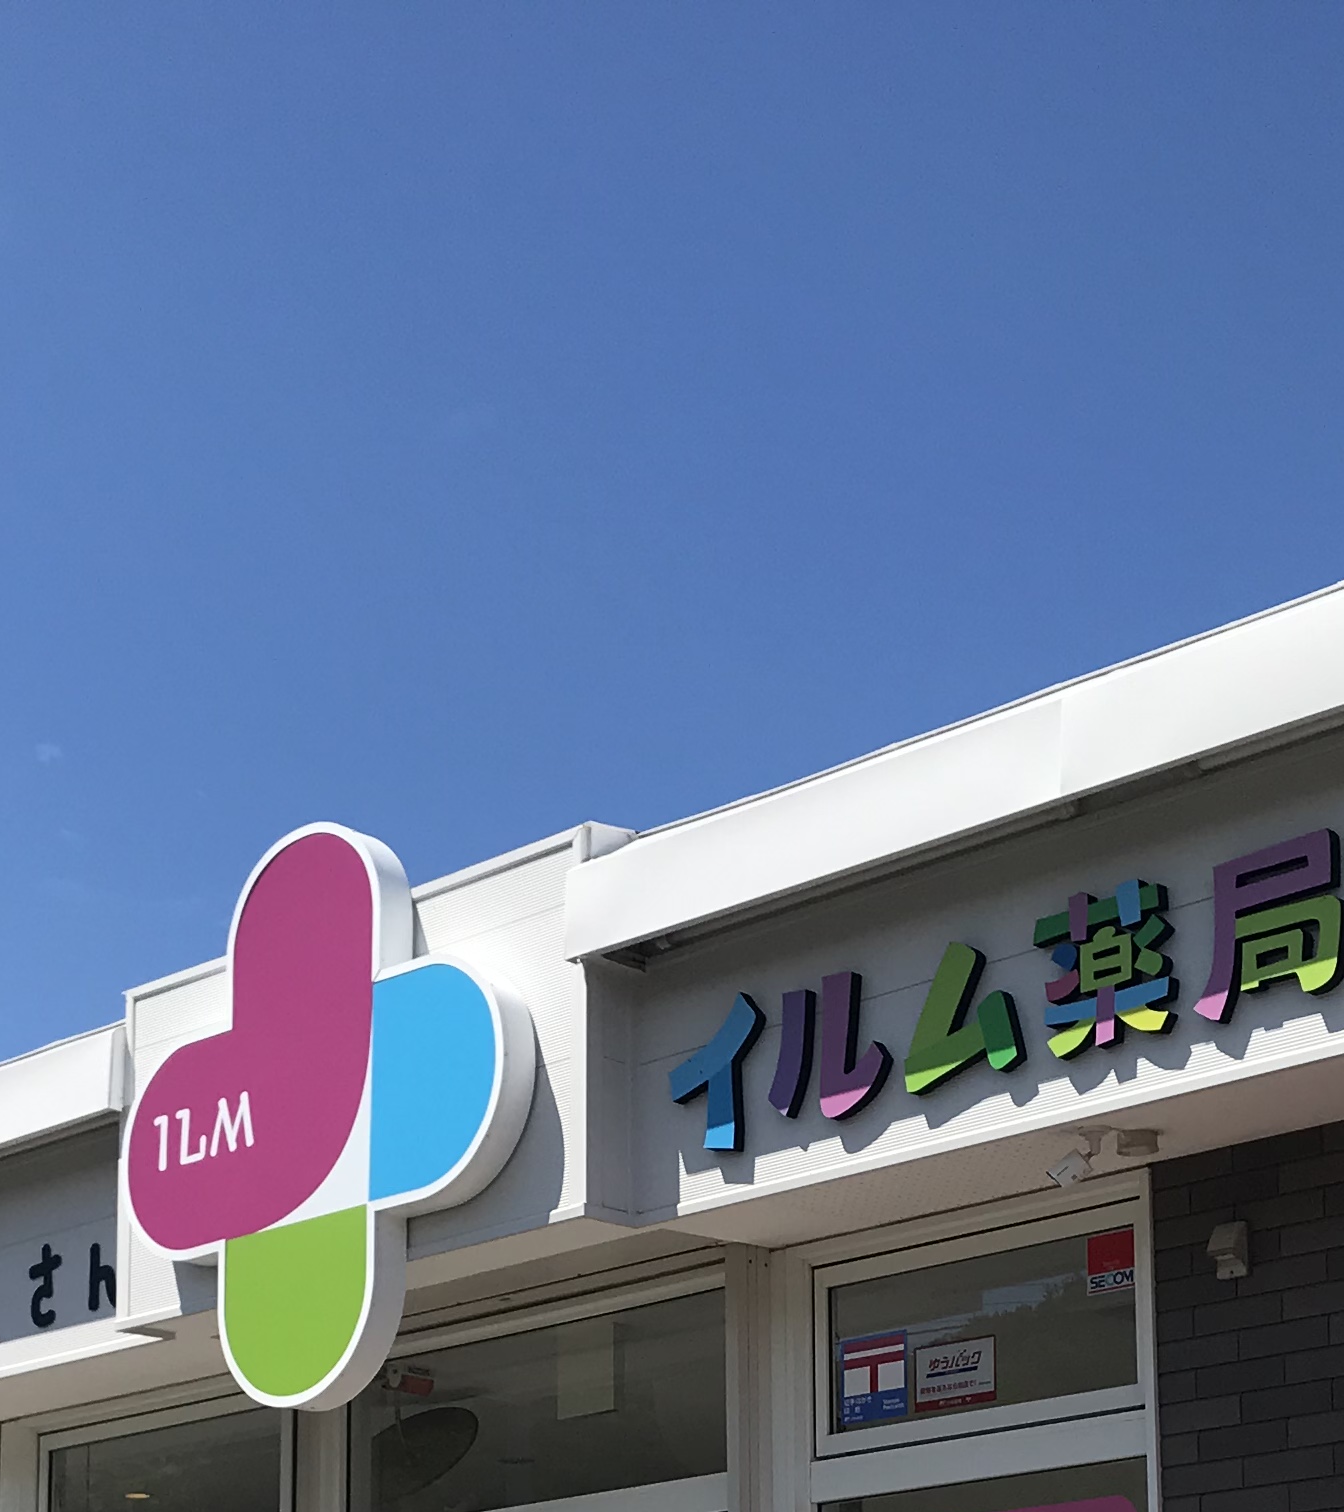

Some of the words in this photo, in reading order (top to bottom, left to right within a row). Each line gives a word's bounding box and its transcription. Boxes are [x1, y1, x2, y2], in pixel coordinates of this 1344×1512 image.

[153, 1090, 255, 1172] ILM
[1090, 1270, 1134, 1290] SECOM
[929, 1349, 982, 1371] ゆうパック
